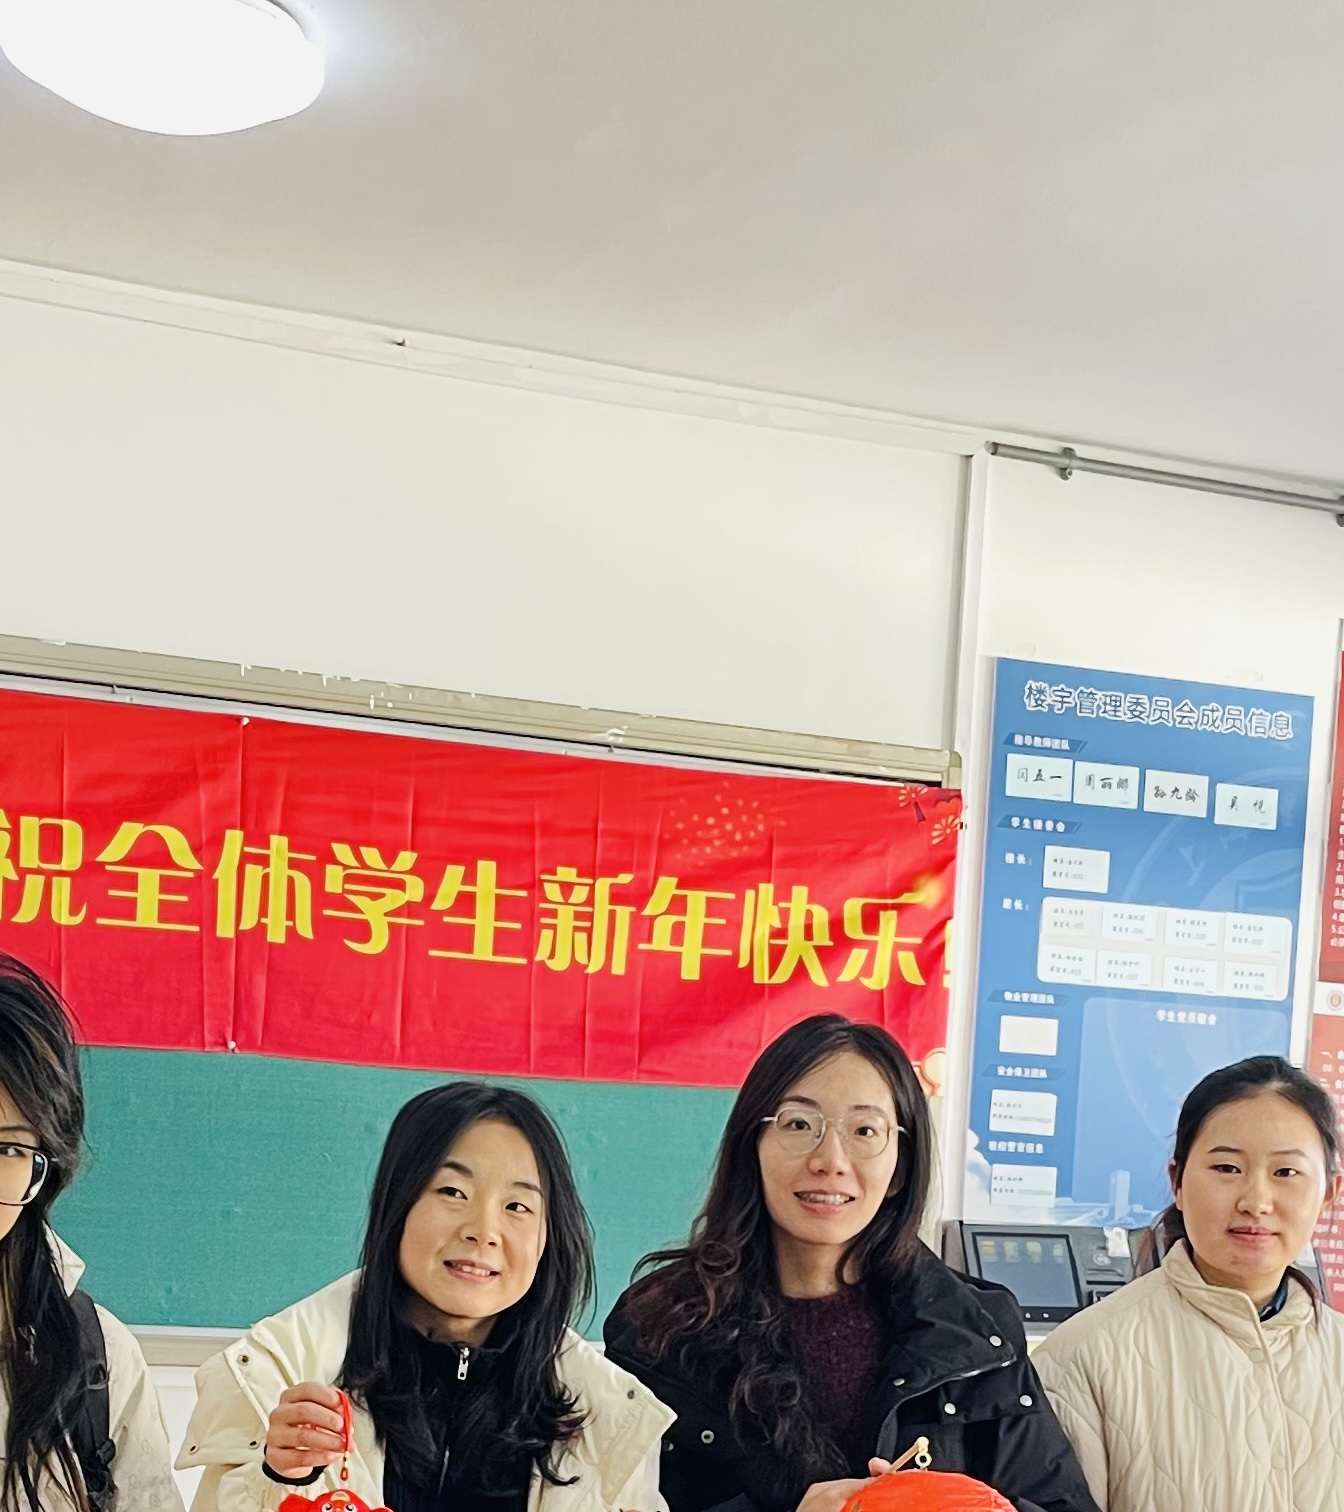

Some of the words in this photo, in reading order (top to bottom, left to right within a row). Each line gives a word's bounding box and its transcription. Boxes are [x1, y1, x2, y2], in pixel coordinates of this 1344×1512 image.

[1024, 680, 1294, 740] 楼宇管理委员会成员信息
